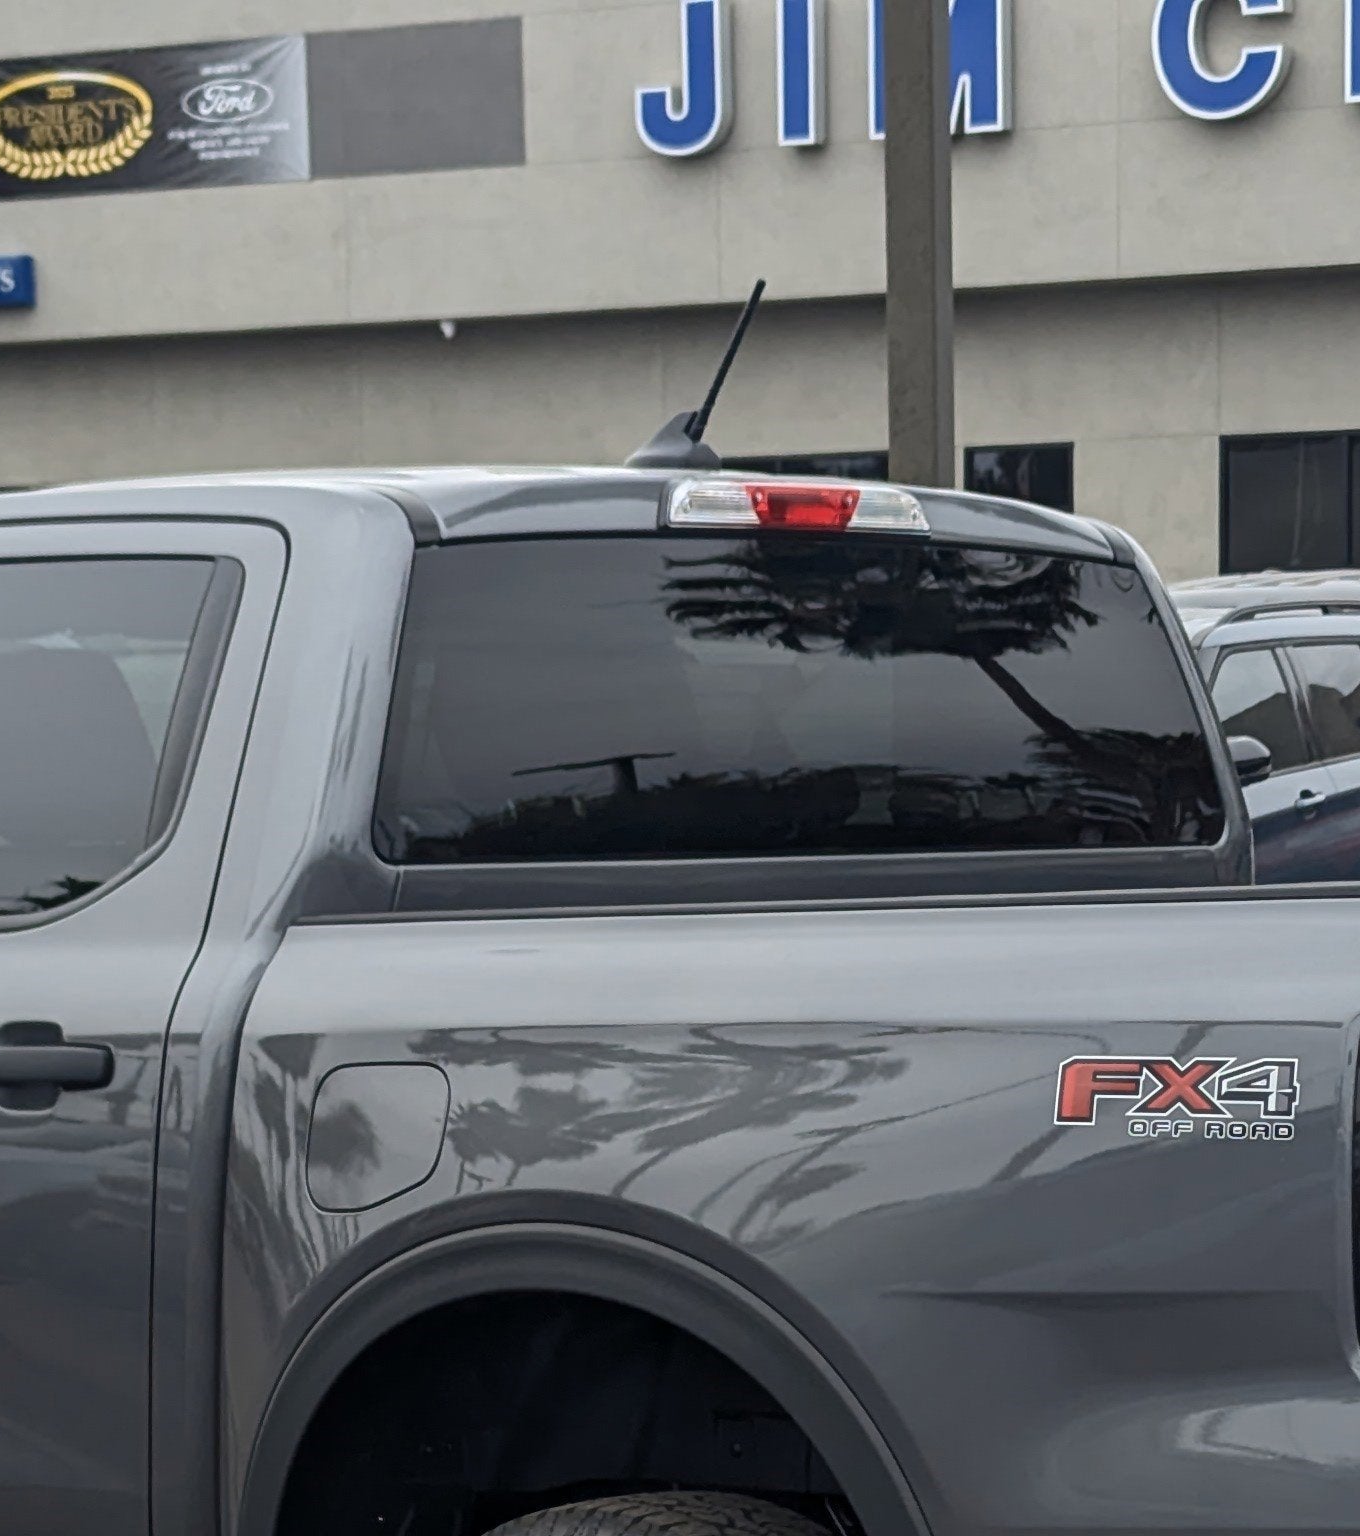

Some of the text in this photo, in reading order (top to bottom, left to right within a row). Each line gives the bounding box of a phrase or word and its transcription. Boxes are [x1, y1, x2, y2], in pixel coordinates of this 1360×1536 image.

[1054, 1056, 1299, 1126] FX4
[1128, 1119, 1295, 1140] OFF ROAD
